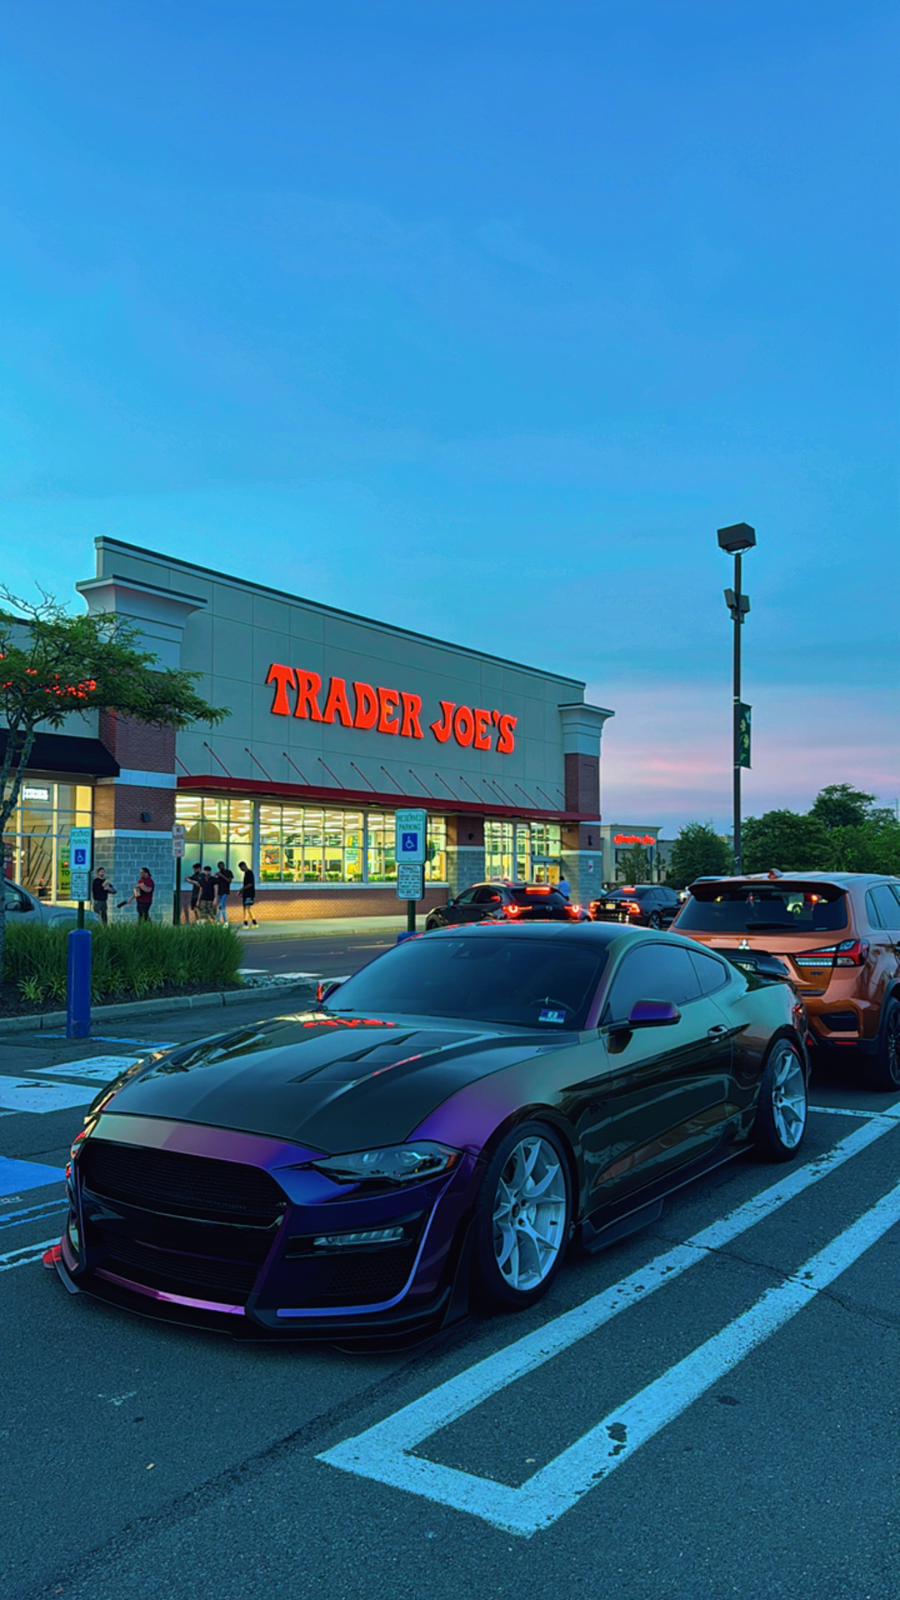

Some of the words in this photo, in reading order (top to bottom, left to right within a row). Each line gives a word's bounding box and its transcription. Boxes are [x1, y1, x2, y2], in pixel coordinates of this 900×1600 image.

[266, 663, 424, 739] TRADER
[430, 701, 518, 754] JOE'S
[399, 823, 420, 831] PARKING
